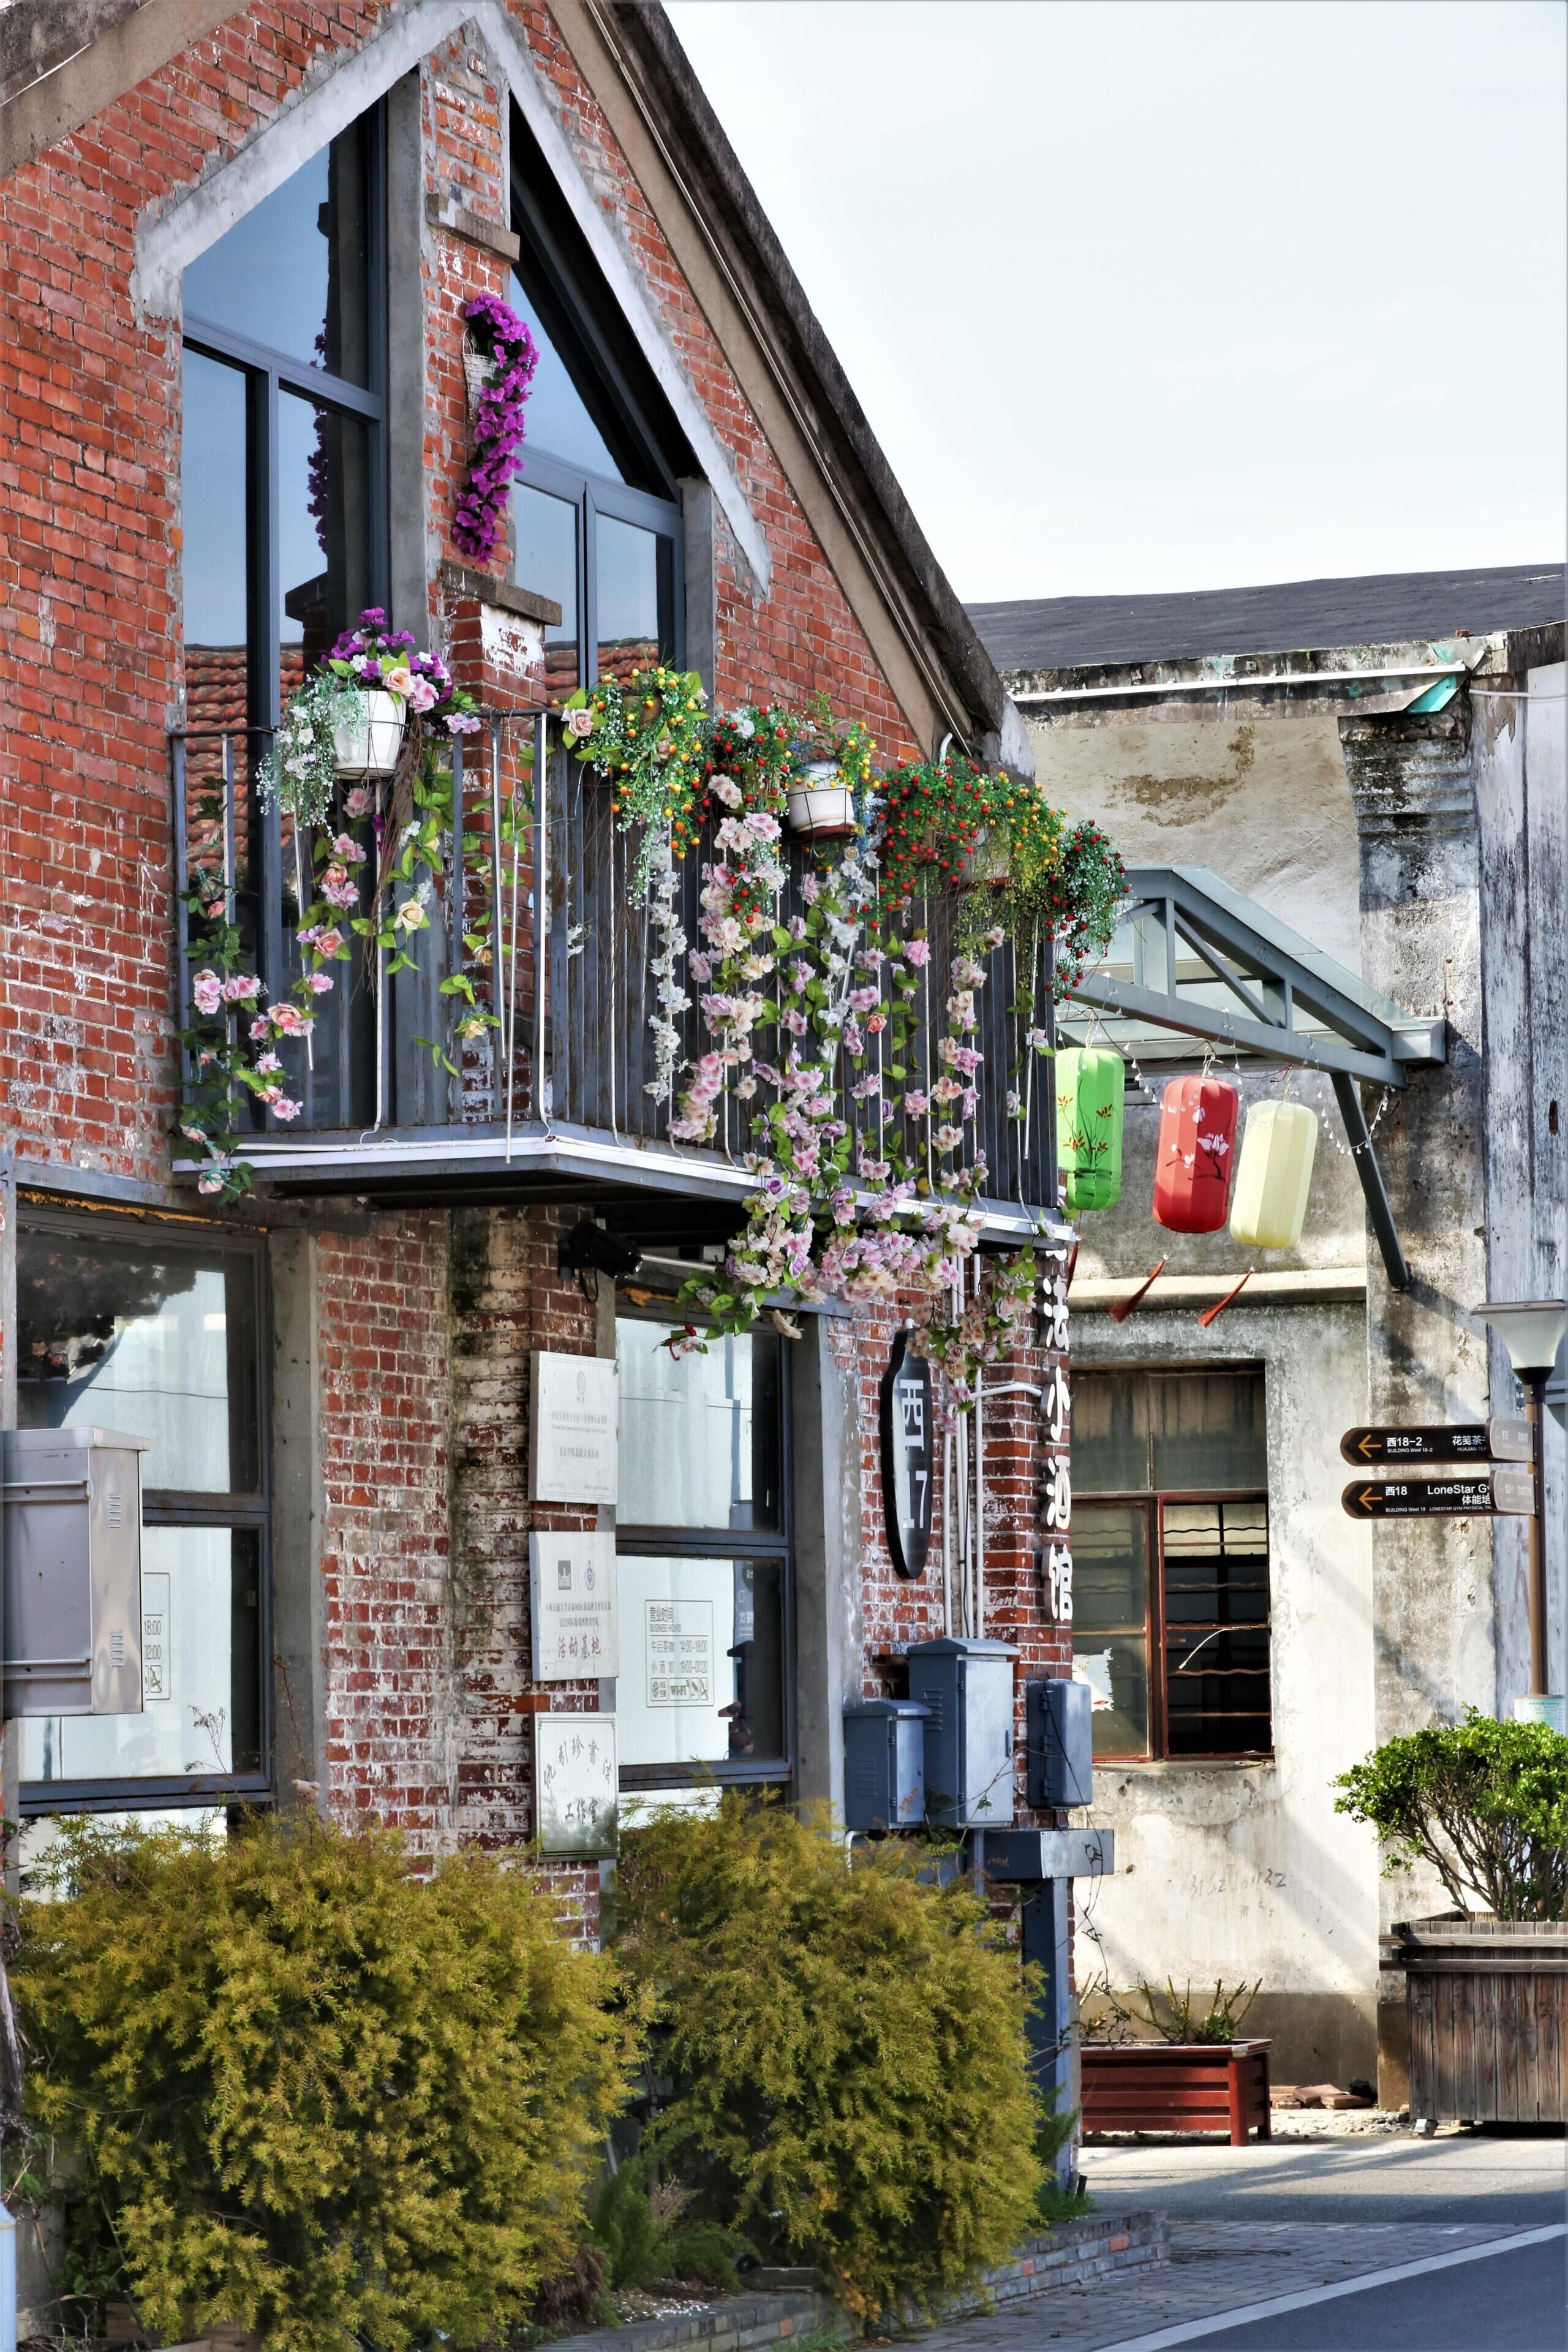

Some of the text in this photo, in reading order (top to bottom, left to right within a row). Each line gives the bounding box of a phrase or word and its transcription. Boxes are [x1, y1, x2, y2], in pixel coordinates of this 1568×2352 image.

[1387, 1437, 1422, 1447] 西18-2
[1385, 1486, 1408, 1496] 西18
[1427, 1484, 1476, 1494] LoneStar
[557, 1632, 601, 1659] 活动基地
